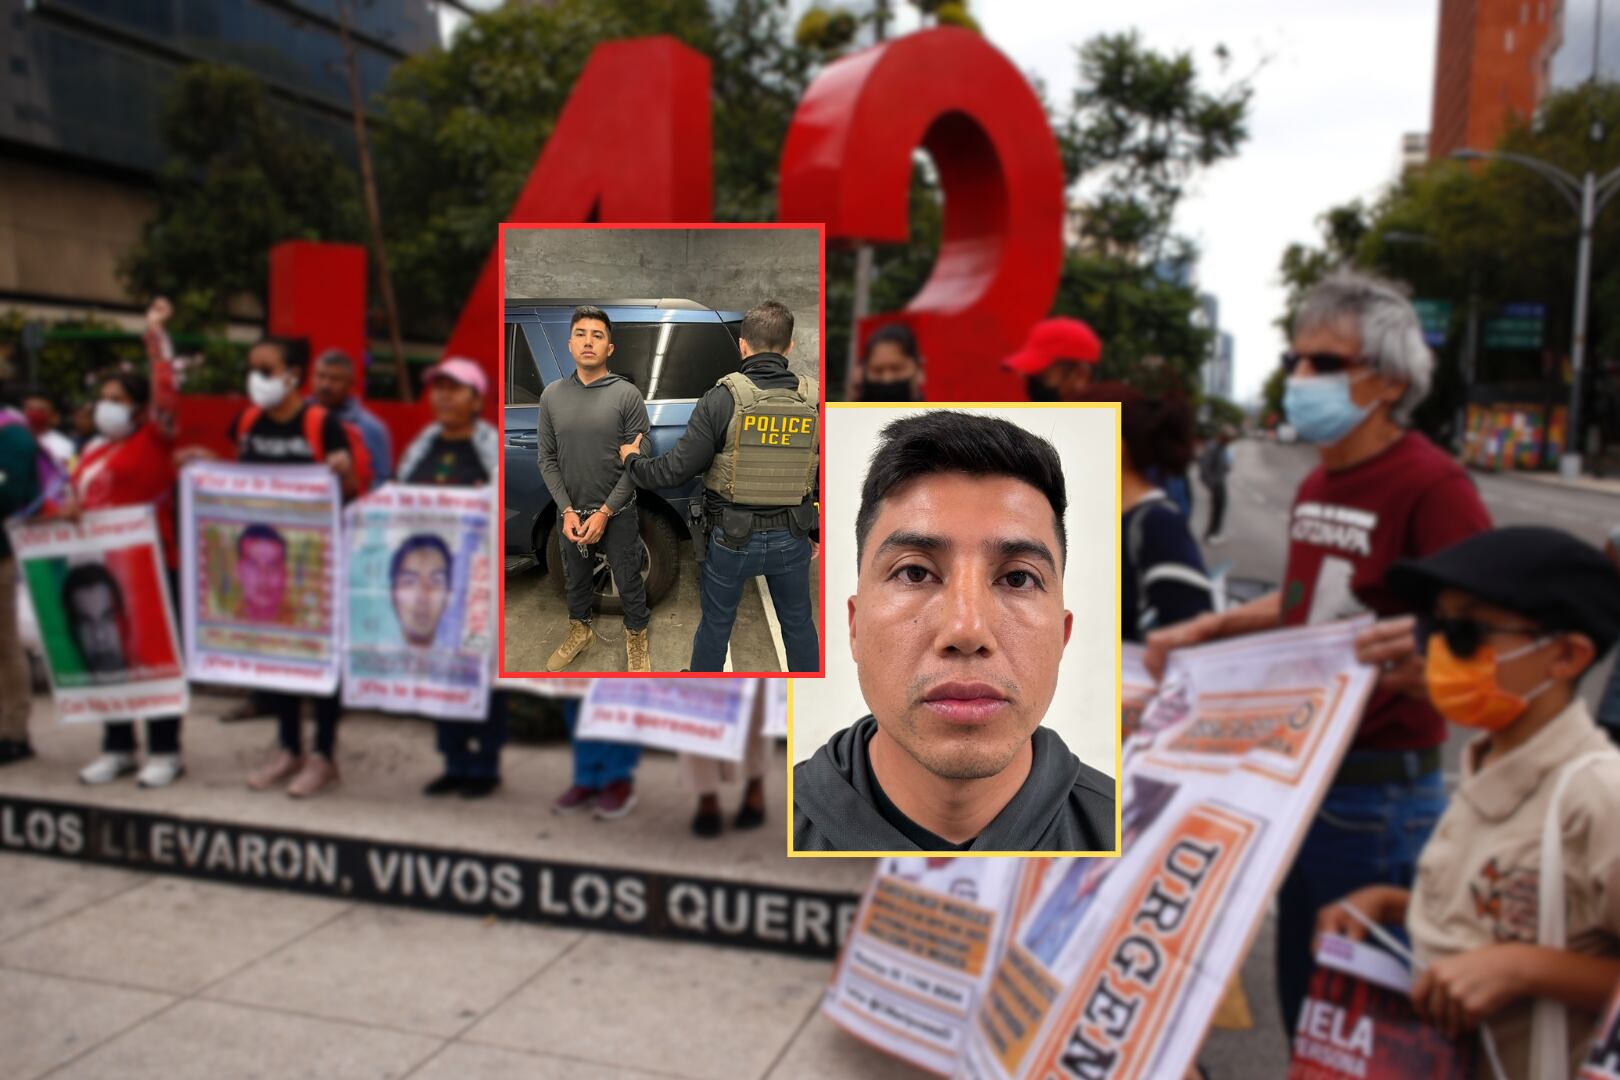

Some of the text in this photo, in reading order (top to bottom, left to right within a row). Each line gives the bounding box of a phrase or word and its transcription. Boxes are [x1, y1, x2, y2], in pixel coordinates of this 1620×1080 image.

[743, 415, 813, 433] POLICE
[761, 433, 792, 446] ICE
[2, 805, 84, 854] LOS
[368, 850, 523, 909] VIVOS
[538, 869, 648, 923] LOS
[1048, 839, 1220, 1080] URGEN
